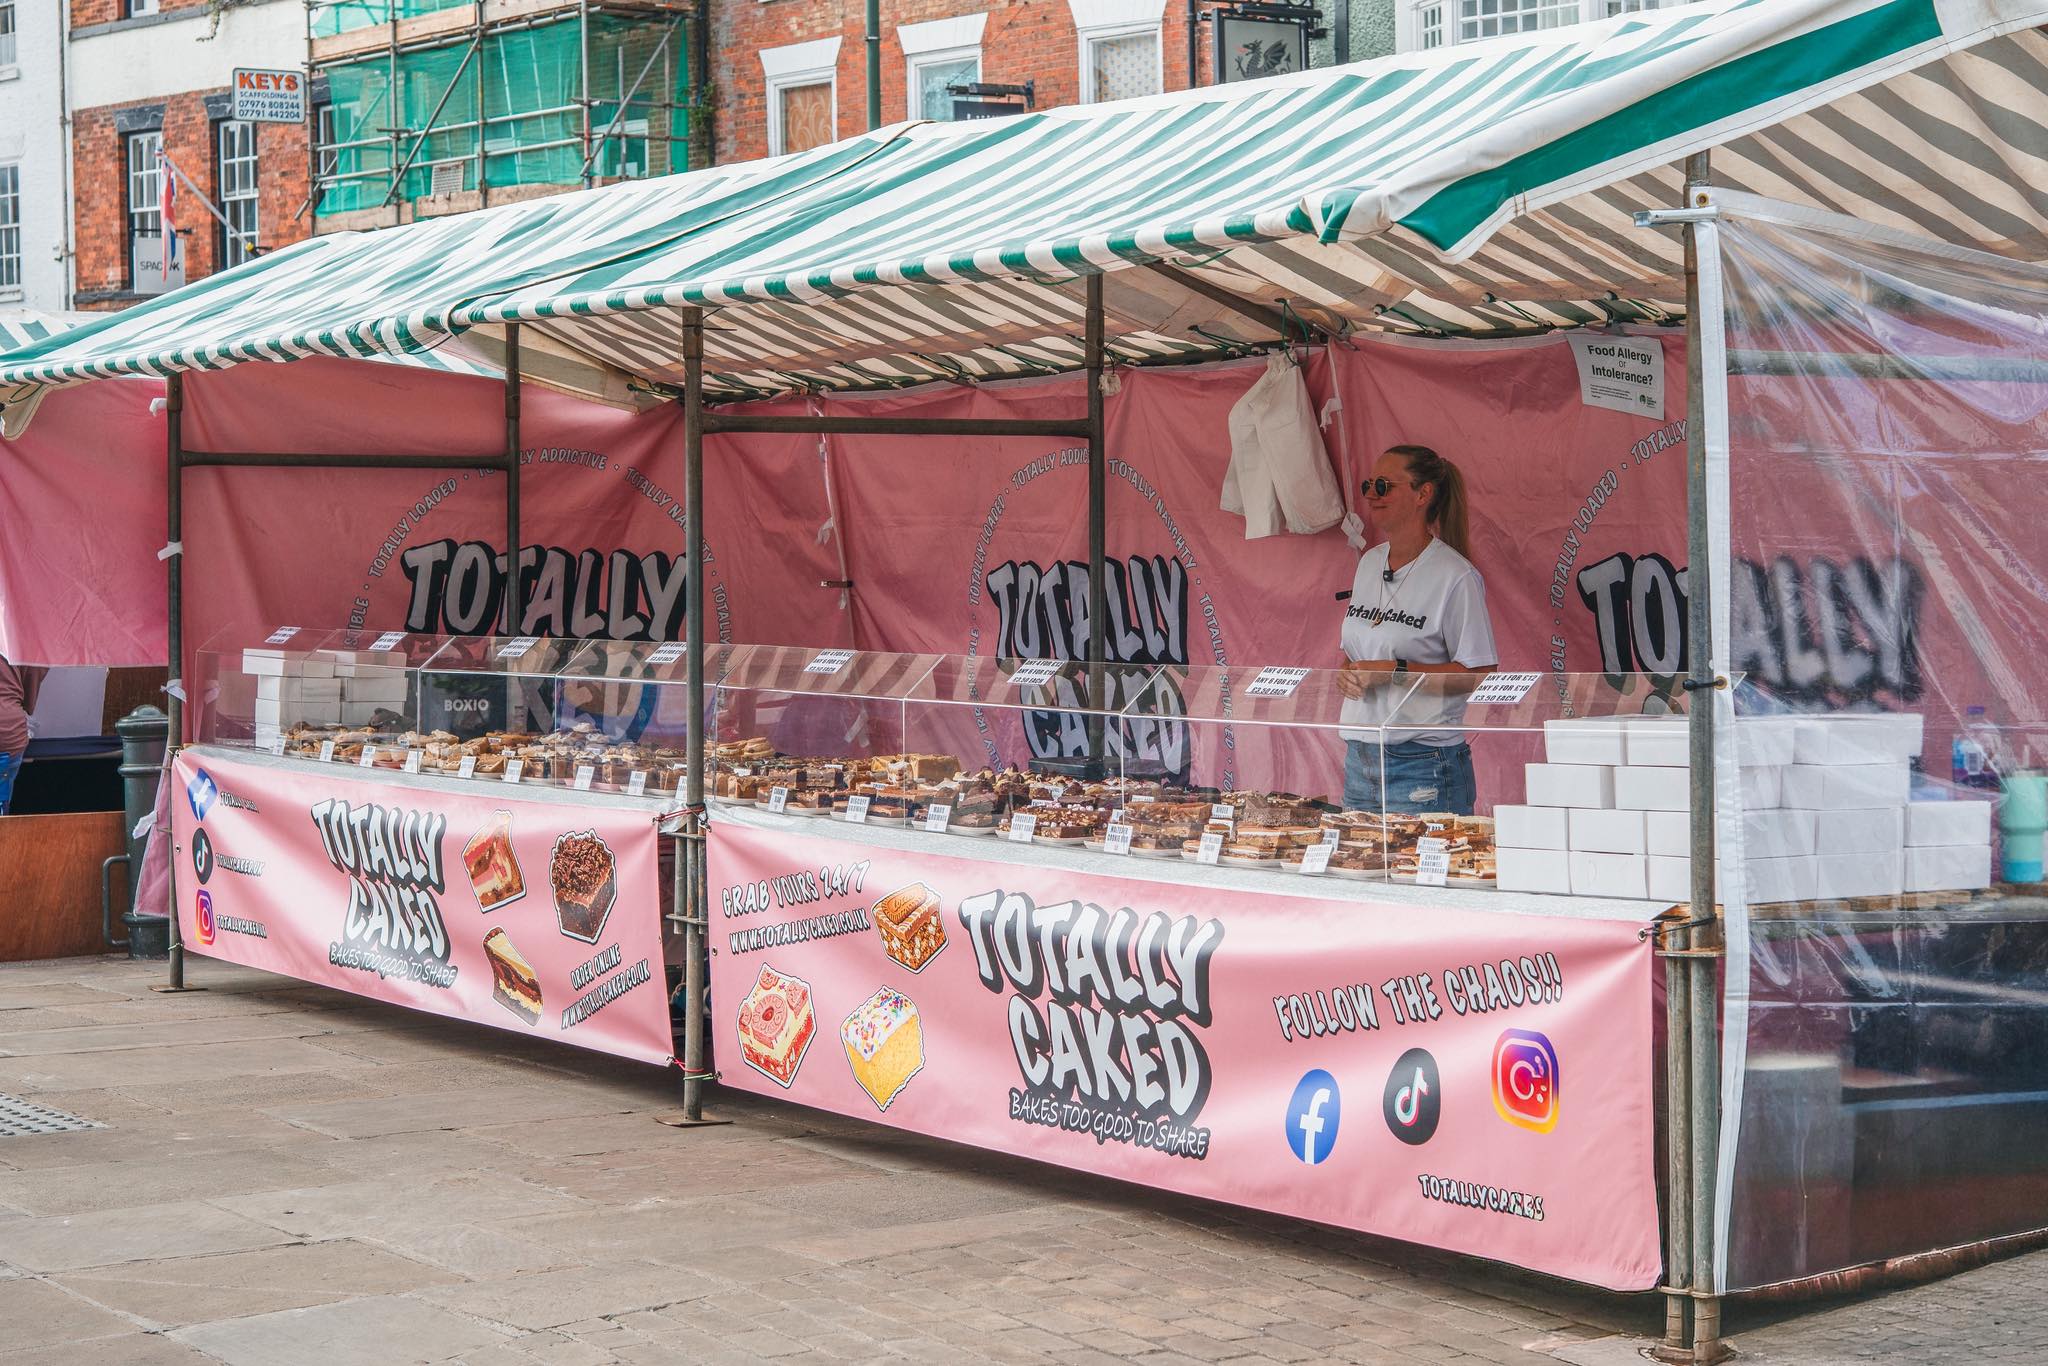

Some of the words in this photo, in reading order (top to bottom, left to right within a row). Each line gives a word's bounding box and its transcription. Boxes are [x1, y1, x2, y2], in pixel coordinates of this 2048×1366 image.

[239, 72, 298, 91] KEYS
[239, 100, 266, 108] 07976
[268, 101, 300, 110] 808244
[240, 91, 288, 99] SCAFFOLDING
[239, 110, 265, 118] 07791
[267, 110, 300, 119] 442204
[1587, 345, 1615, 357] Food
[1617, 347, 1652, 365] Allergy
[1591, 365, 1653, 385] Intolerance?
[539, 448, 608, 470] ADDICTIVE
[1011, 451, 1057, 490] TOTALLY
[1631, 419, 1688, 465] TOTALLY
[625, 466, 672, 506] TOTALLY
[1108, 458, 1156, 501] TOTALLY
[1155, 498, 1197, 570] NAUGHTY
[368, 518, 411, 579] TOTALLY
[408, 478, 459, 523] LOADED
[969, 542, 986, 606] TOTALLY
[980, 493, 1005, 545] LOADED
[1551, 528, 1582, 608] TOTALLY
[1573, 469, 1619, 534] LOADED
[401, 538, 690, 646] TOTALLY
[710, 583, 732, 645] TOTALLY
[986, 554, 1190, 677] TOTALLY
[1200, 591, 1228, 668] TOTALLY
[444, 699, 489, 712] BOXIO
[1252, 686, 1271, 695] £3.50
[311, 797, 447, 895] TOTALLY
[344, 873, 451, 962] CAKED
[722, 880, 769, 918] GRAB
[771, 871, 820, 908] YOURS
[819, 860, 871, 899] 24/7
[729, 908, 871, 955] WWW.TOTALLYCAKED.CO.UK
[959, 888, 1225, 1028] TOTALLY
[330, 944, 361, 966] BAKES
[361, 951, 381, 971] TOO
[380, 955, 408, 976] GOOD
[410, 961, 423, 978] TO
[422, 964, 457, 987] SHARE
[561, 958, 650, 1030] WWW.TOTALLYCAKED.CO.UK
[571, 960, 595, 991] ORDER
[594, 943, 621, 976] ONLINE
[1272, 982, 1380, 1042] FOLLOW
[1382, 972, 1443, 1026] THE
[1443, 951, 1564, 1016] CHAOS!!
[1008, 993, 1212, 1122] CAKED
[1010, 1091, 1058, 1124] BAKES
[1061, 1102, 1090, 1130] TOO
[1094, 1110, 1133, 1139] GOOD
[1137, 1119, 1155, 1143] TO
[1156, 1124, 1209, 1156] SHARE
